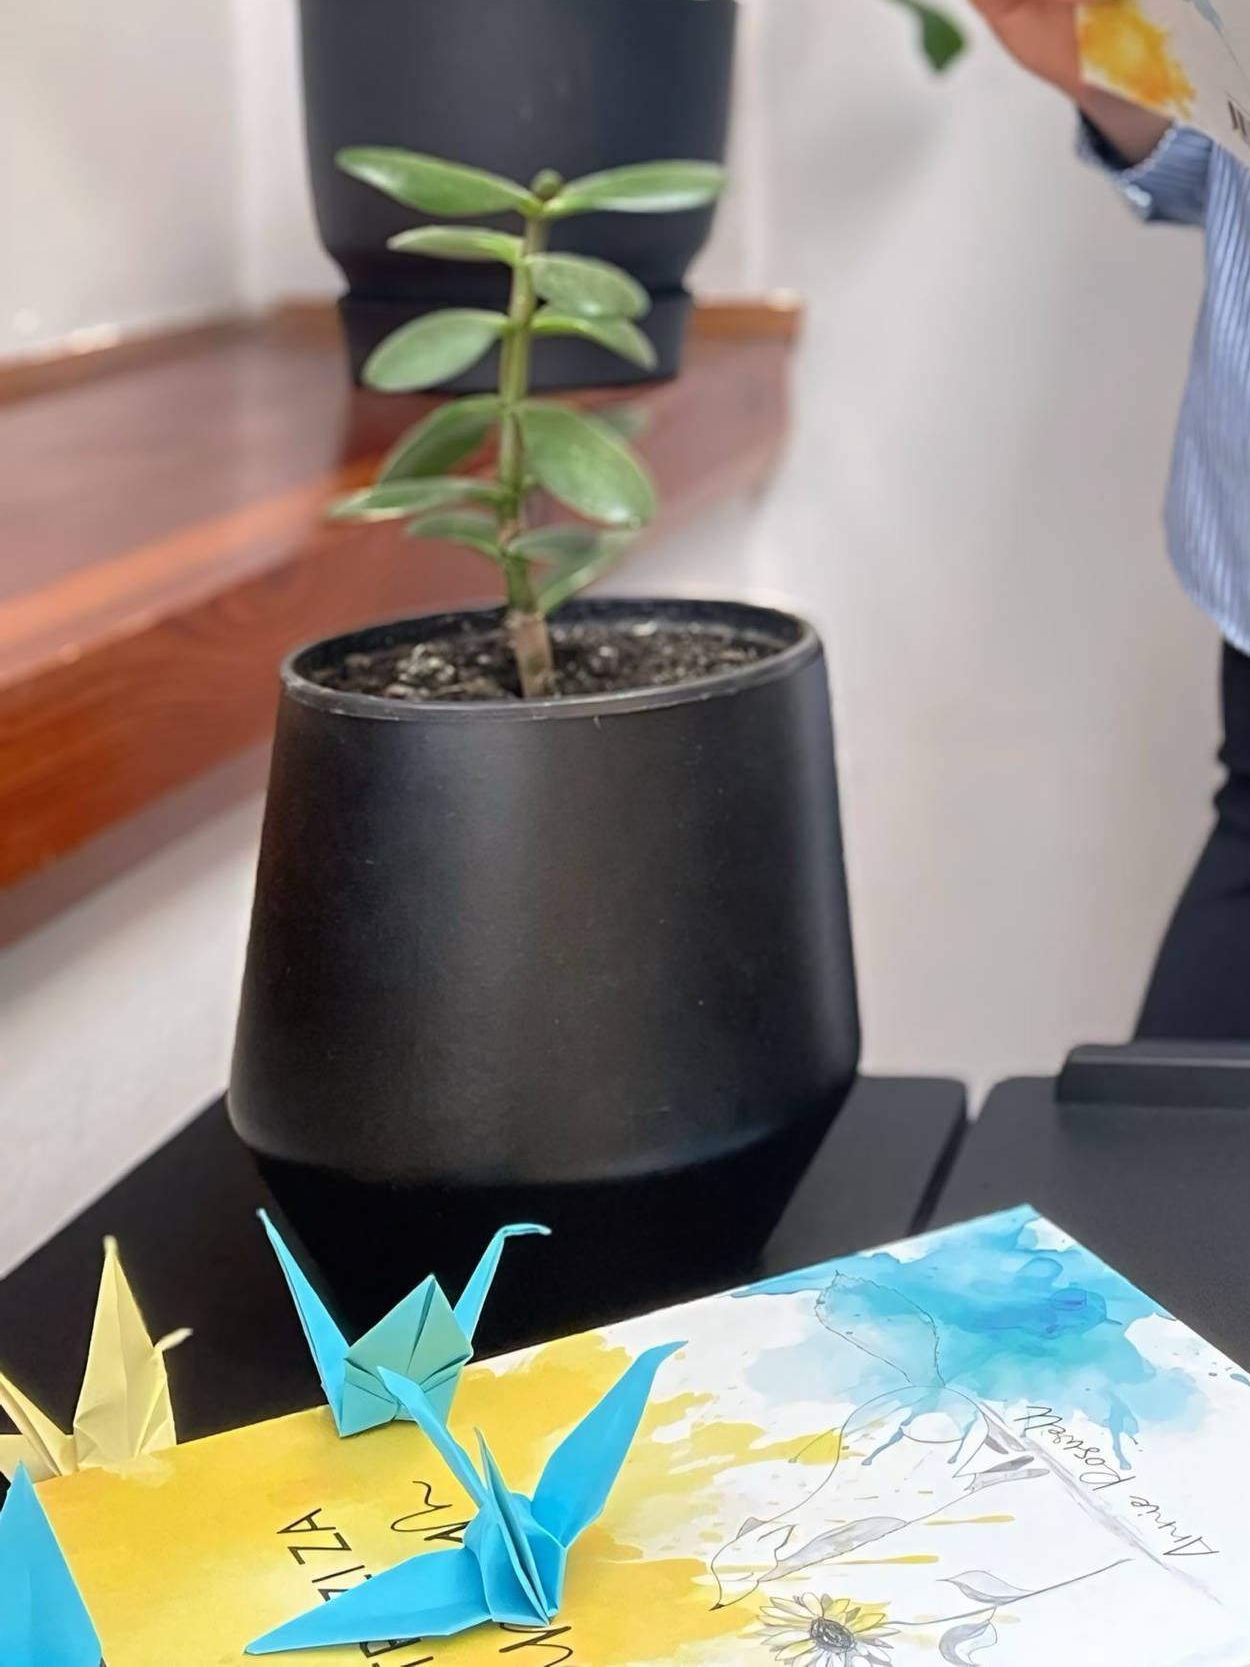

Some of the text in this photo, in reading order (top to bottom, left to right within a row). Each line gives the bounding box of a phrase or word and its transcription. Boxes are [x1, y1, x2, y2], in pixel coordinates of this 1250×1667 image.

[1013, 1405, 1220, 1556] Annie Roswell
[276, 1507, 352, 1565] ZA
